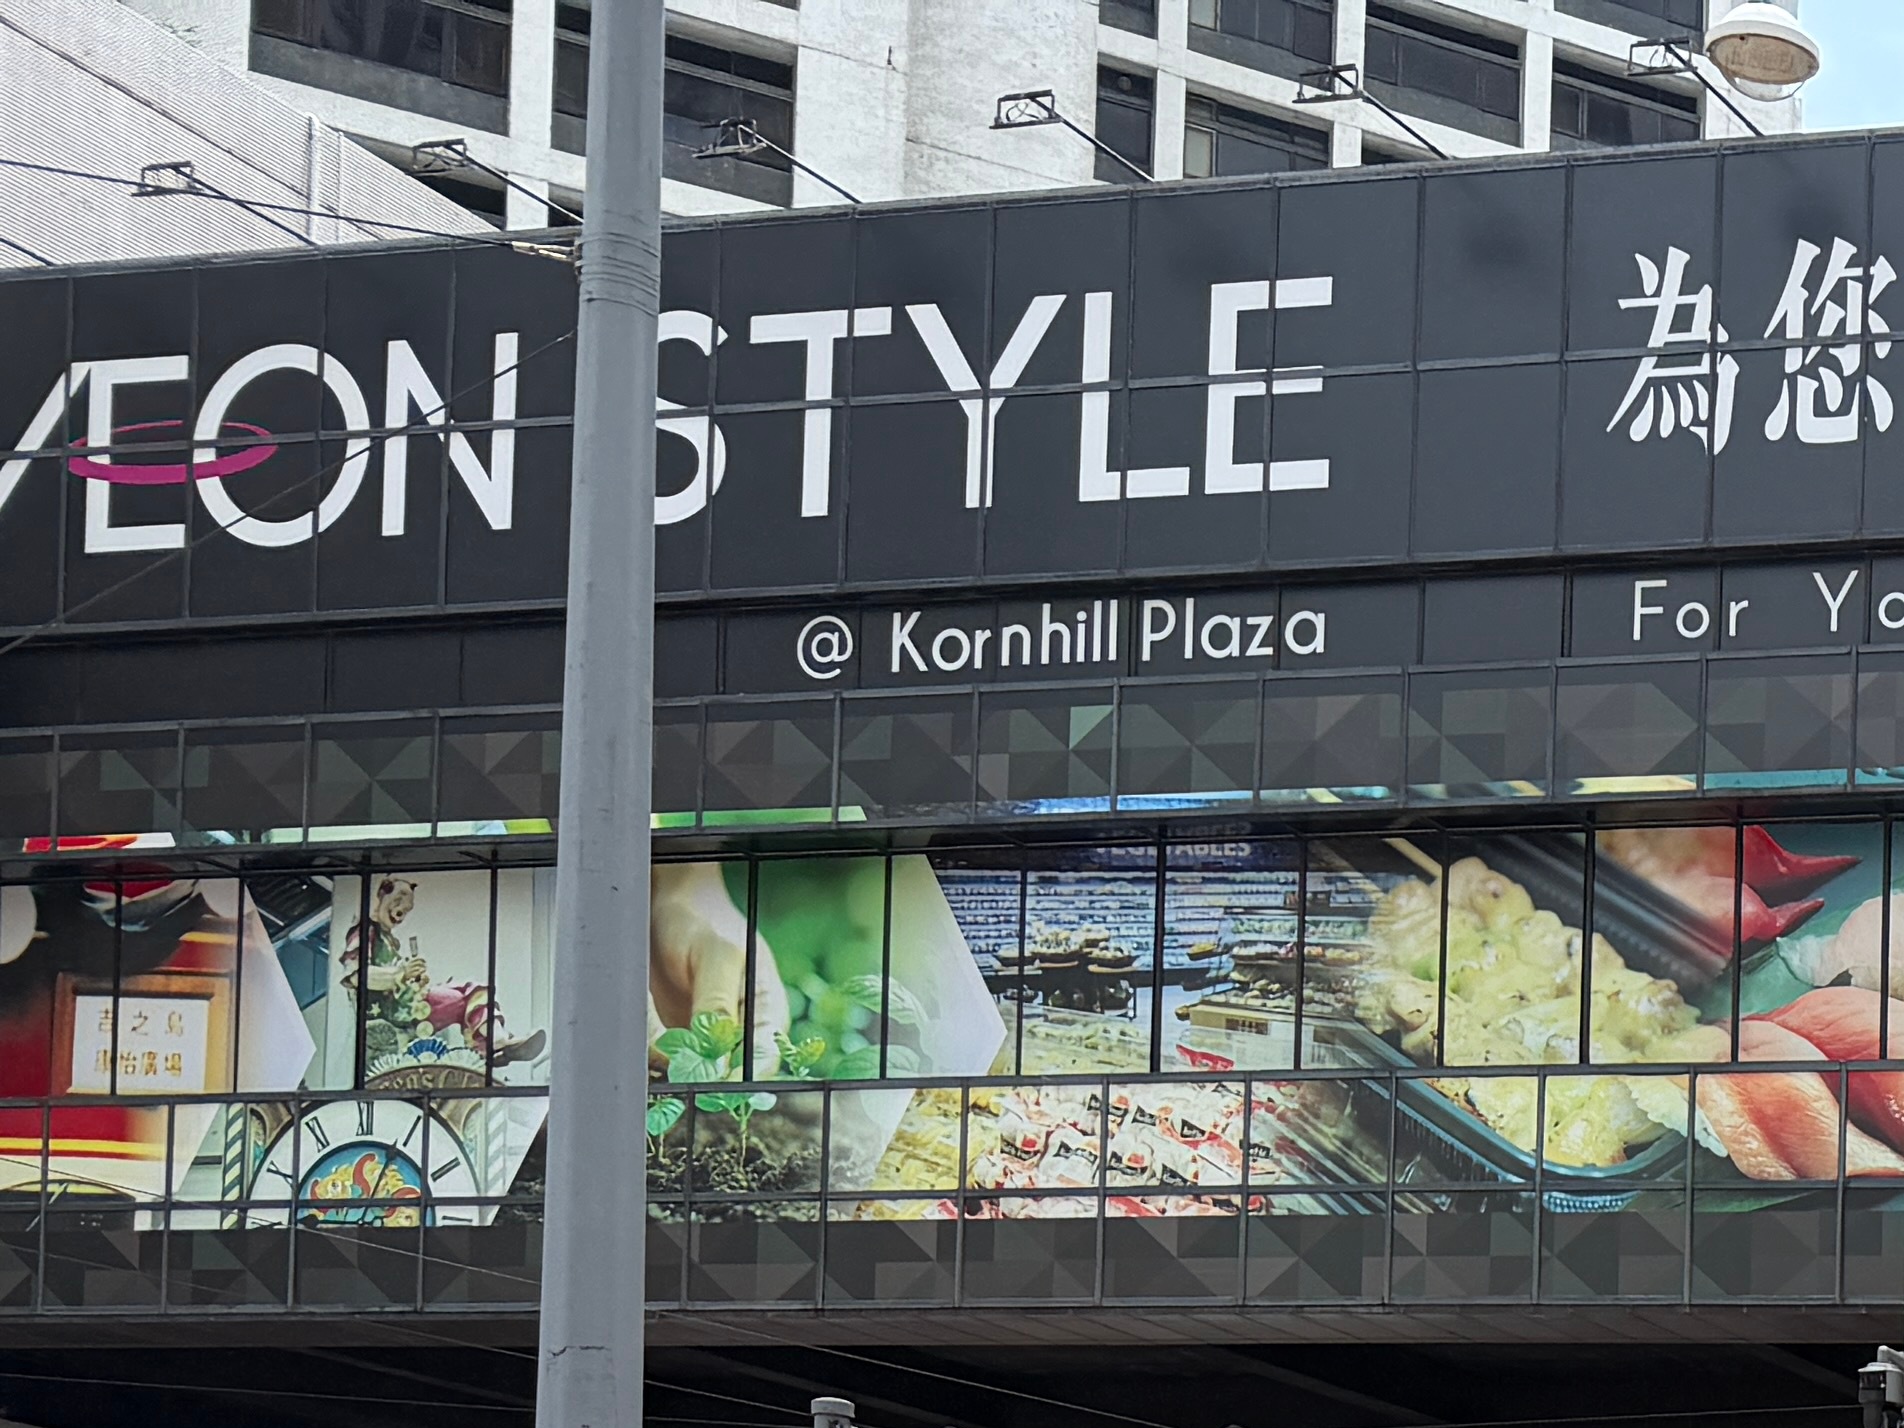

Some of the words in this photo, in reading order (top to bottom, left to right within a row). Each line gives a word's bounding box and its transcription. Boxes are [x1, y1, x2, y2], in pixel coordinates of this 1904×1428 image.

[652, 274, 1335, 528] STYLE
[888, 600, 1120, 675] Kornhill
[1140, 597, 1328, 663] Plaza
[1630, 577, 1750, 642] For
